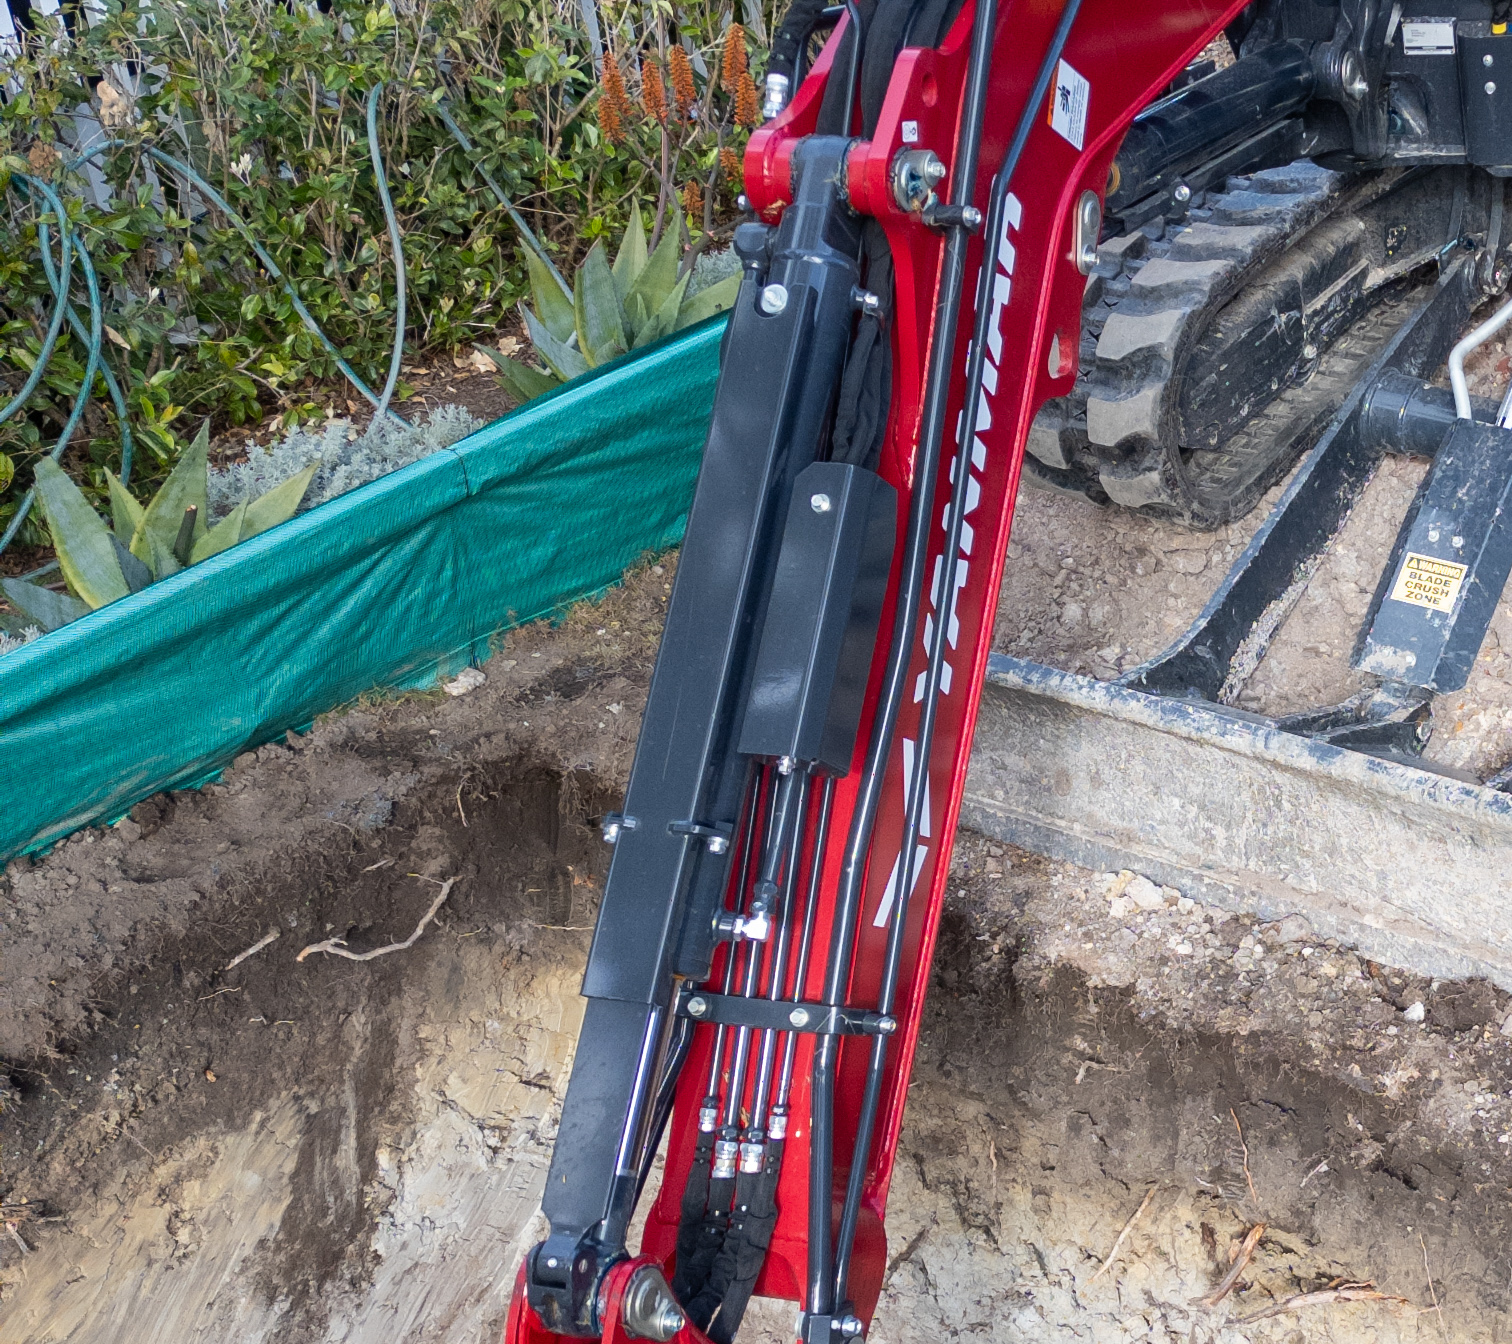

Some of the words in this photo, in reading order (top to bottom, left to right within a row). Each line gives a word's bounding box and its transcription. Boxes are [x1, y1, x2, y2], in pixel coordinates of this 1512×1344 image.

[914, 174, 1022, 705] YANMAR
[1419, 559, 1461, 578] WARNING
[1408, 571, 1453, 588] BLADE
[1404, 580, 1450, 598] CRUSH
[1404, 590, 1442, 605] ZONE
